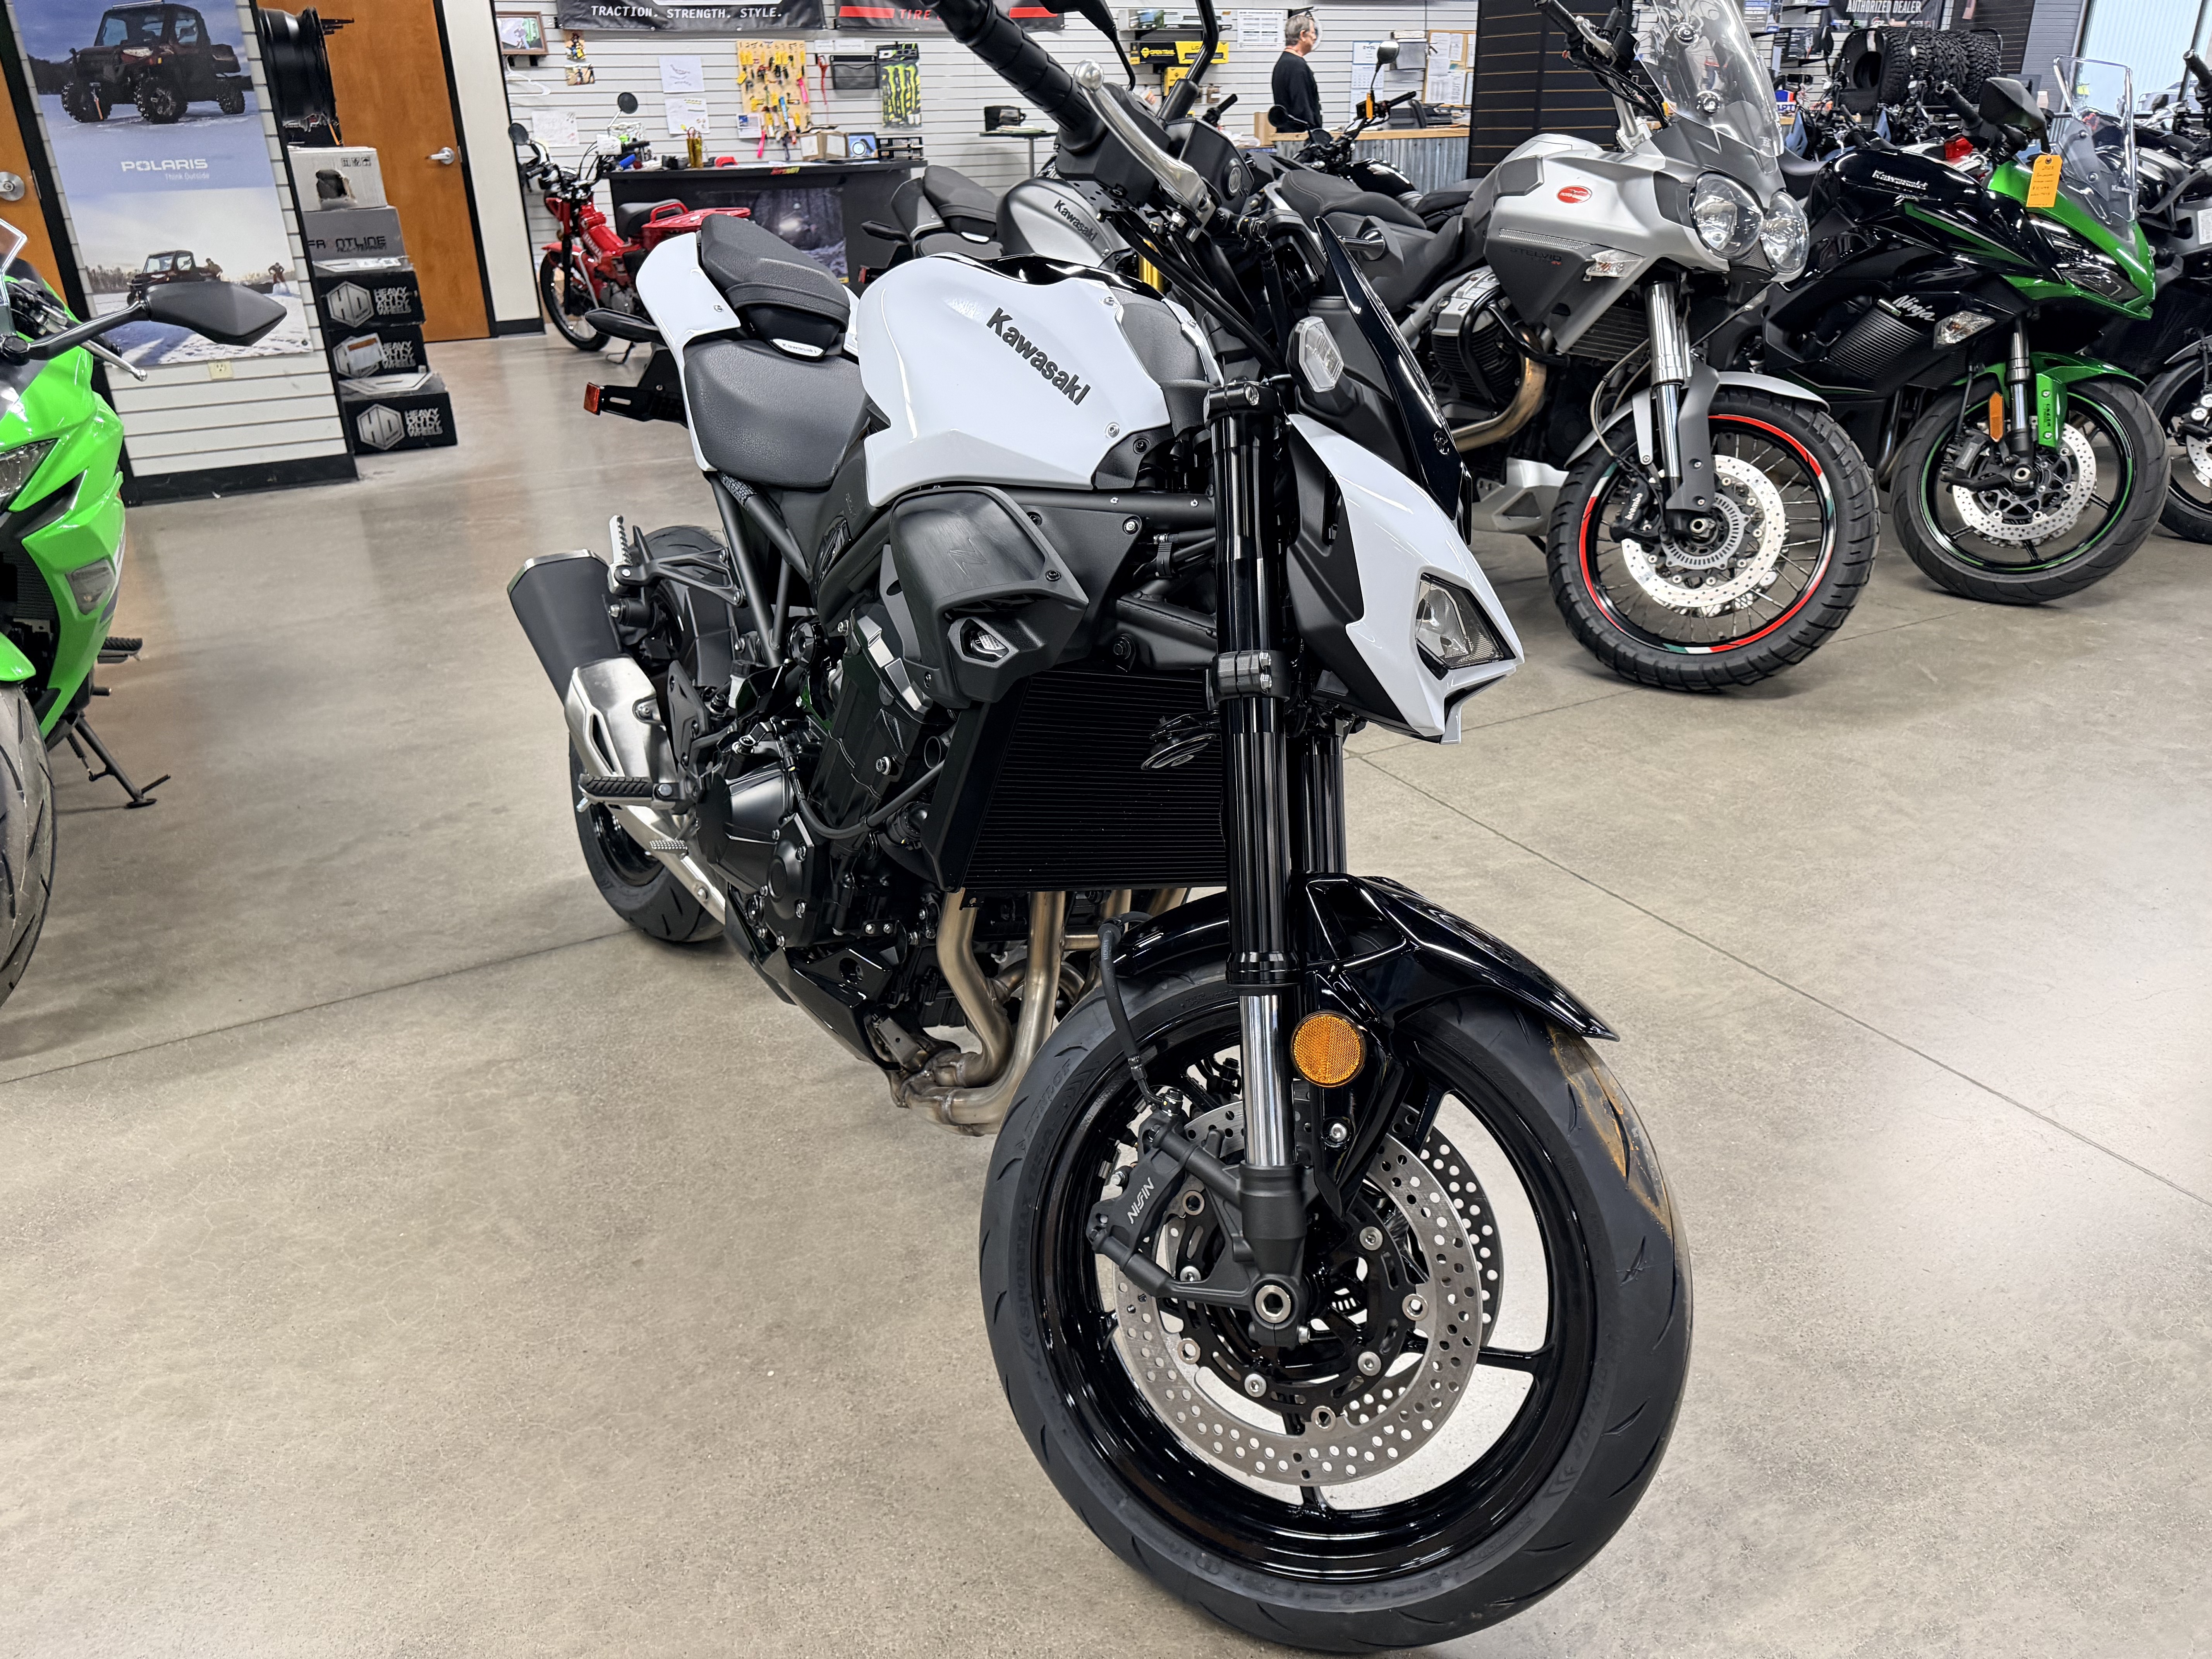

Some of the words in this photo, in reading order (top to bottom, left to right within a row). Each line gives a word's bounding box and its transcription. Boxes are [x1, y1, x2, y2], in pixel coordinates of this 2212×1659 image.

[590, 5, 658, 17] TRACTION.
[666, 8, 731, 19] STRENGTH.
[740, 7, 782, 18] STYLE.
[899, 9, 932, 20] TIRE
[1846, 0, 1891, 13] AUTHORIZED
[1893, 0, 1922, 13] DEALER
[120, 158, 208, 172] POLARIS
[1054, 199, 1097, 242] Kawasaki
[1510, 247, 1562, 261] STELVIO
[1892, 295, 1936, 321] Ninja
[986, 307, 1091, 405] Kawasaki
[1625, 493, 1643, 520] brembo
[1126, 1176, 1156, 1224] NISSIN
